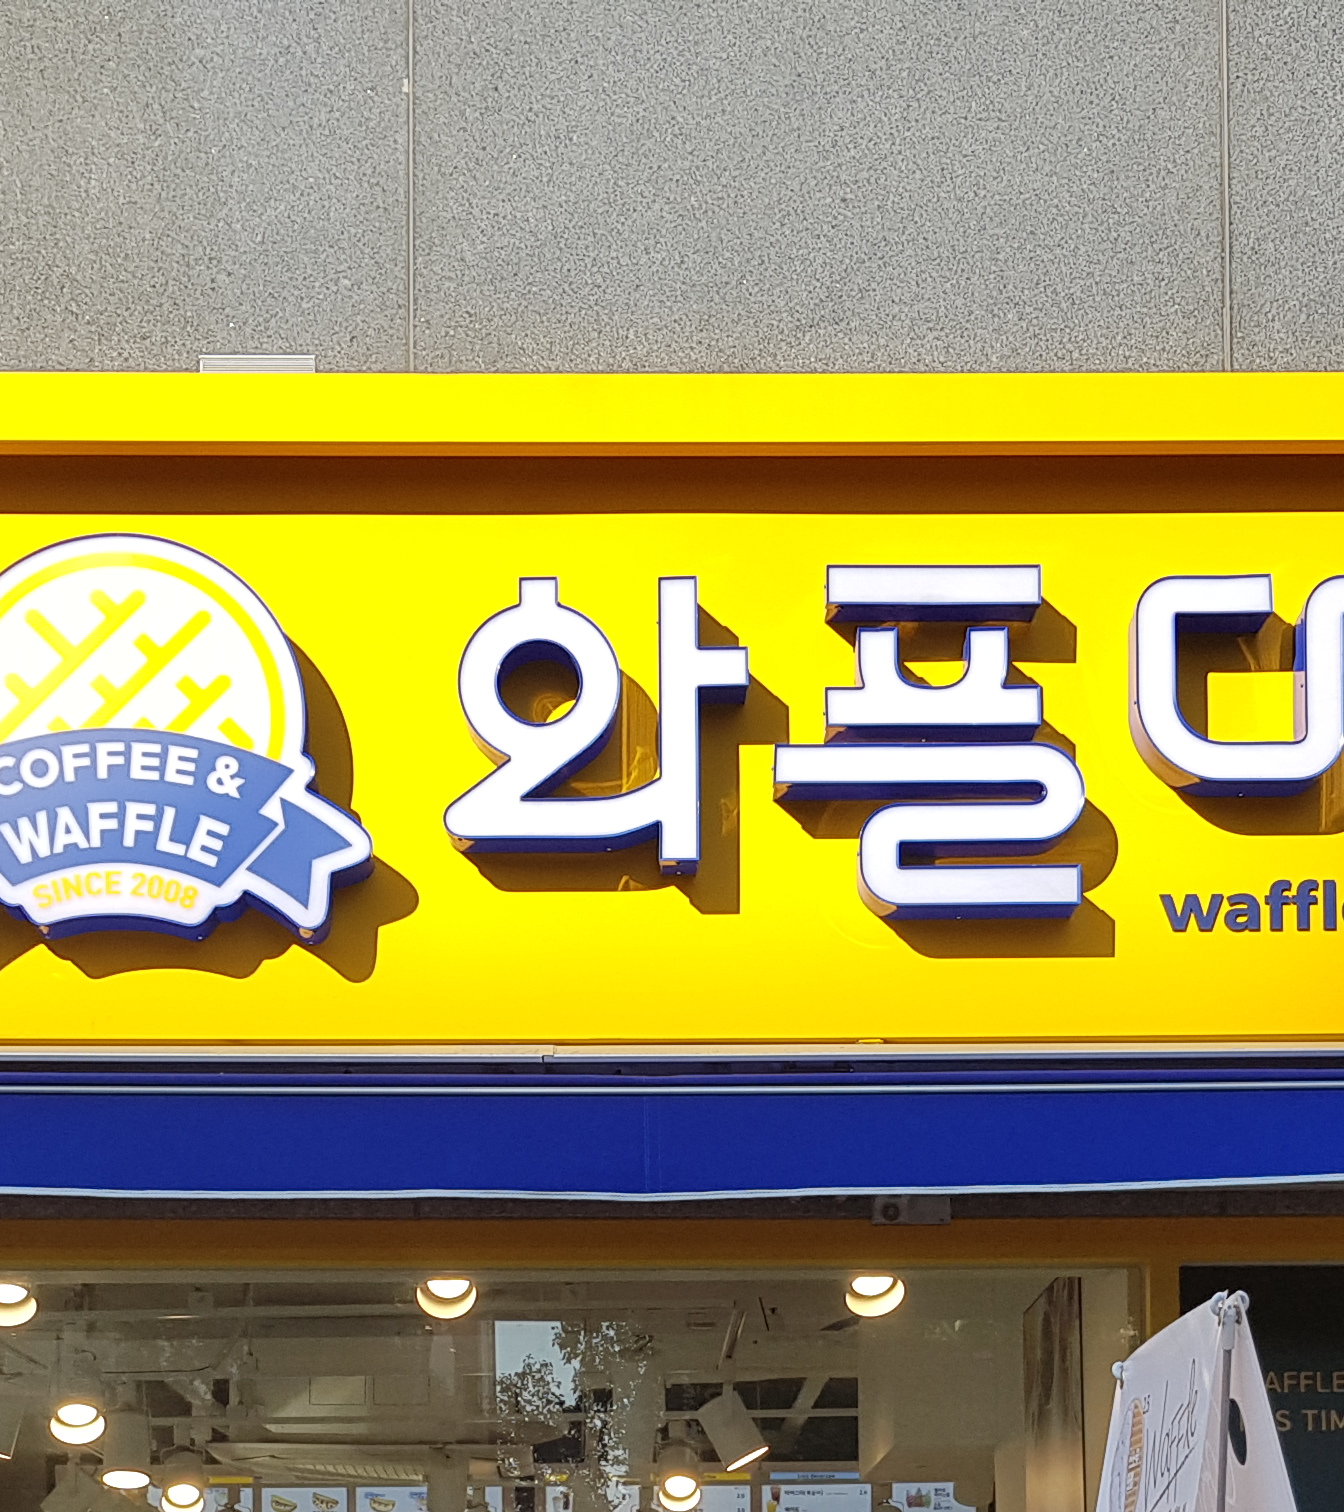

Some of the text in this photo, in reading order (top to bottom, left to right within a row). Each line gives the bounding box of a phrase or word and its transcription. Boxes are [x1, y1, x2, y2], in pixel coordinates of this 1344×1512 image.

[206, 756, 245, 799] &
[33, 869, 200, 910] SINCE 2008
